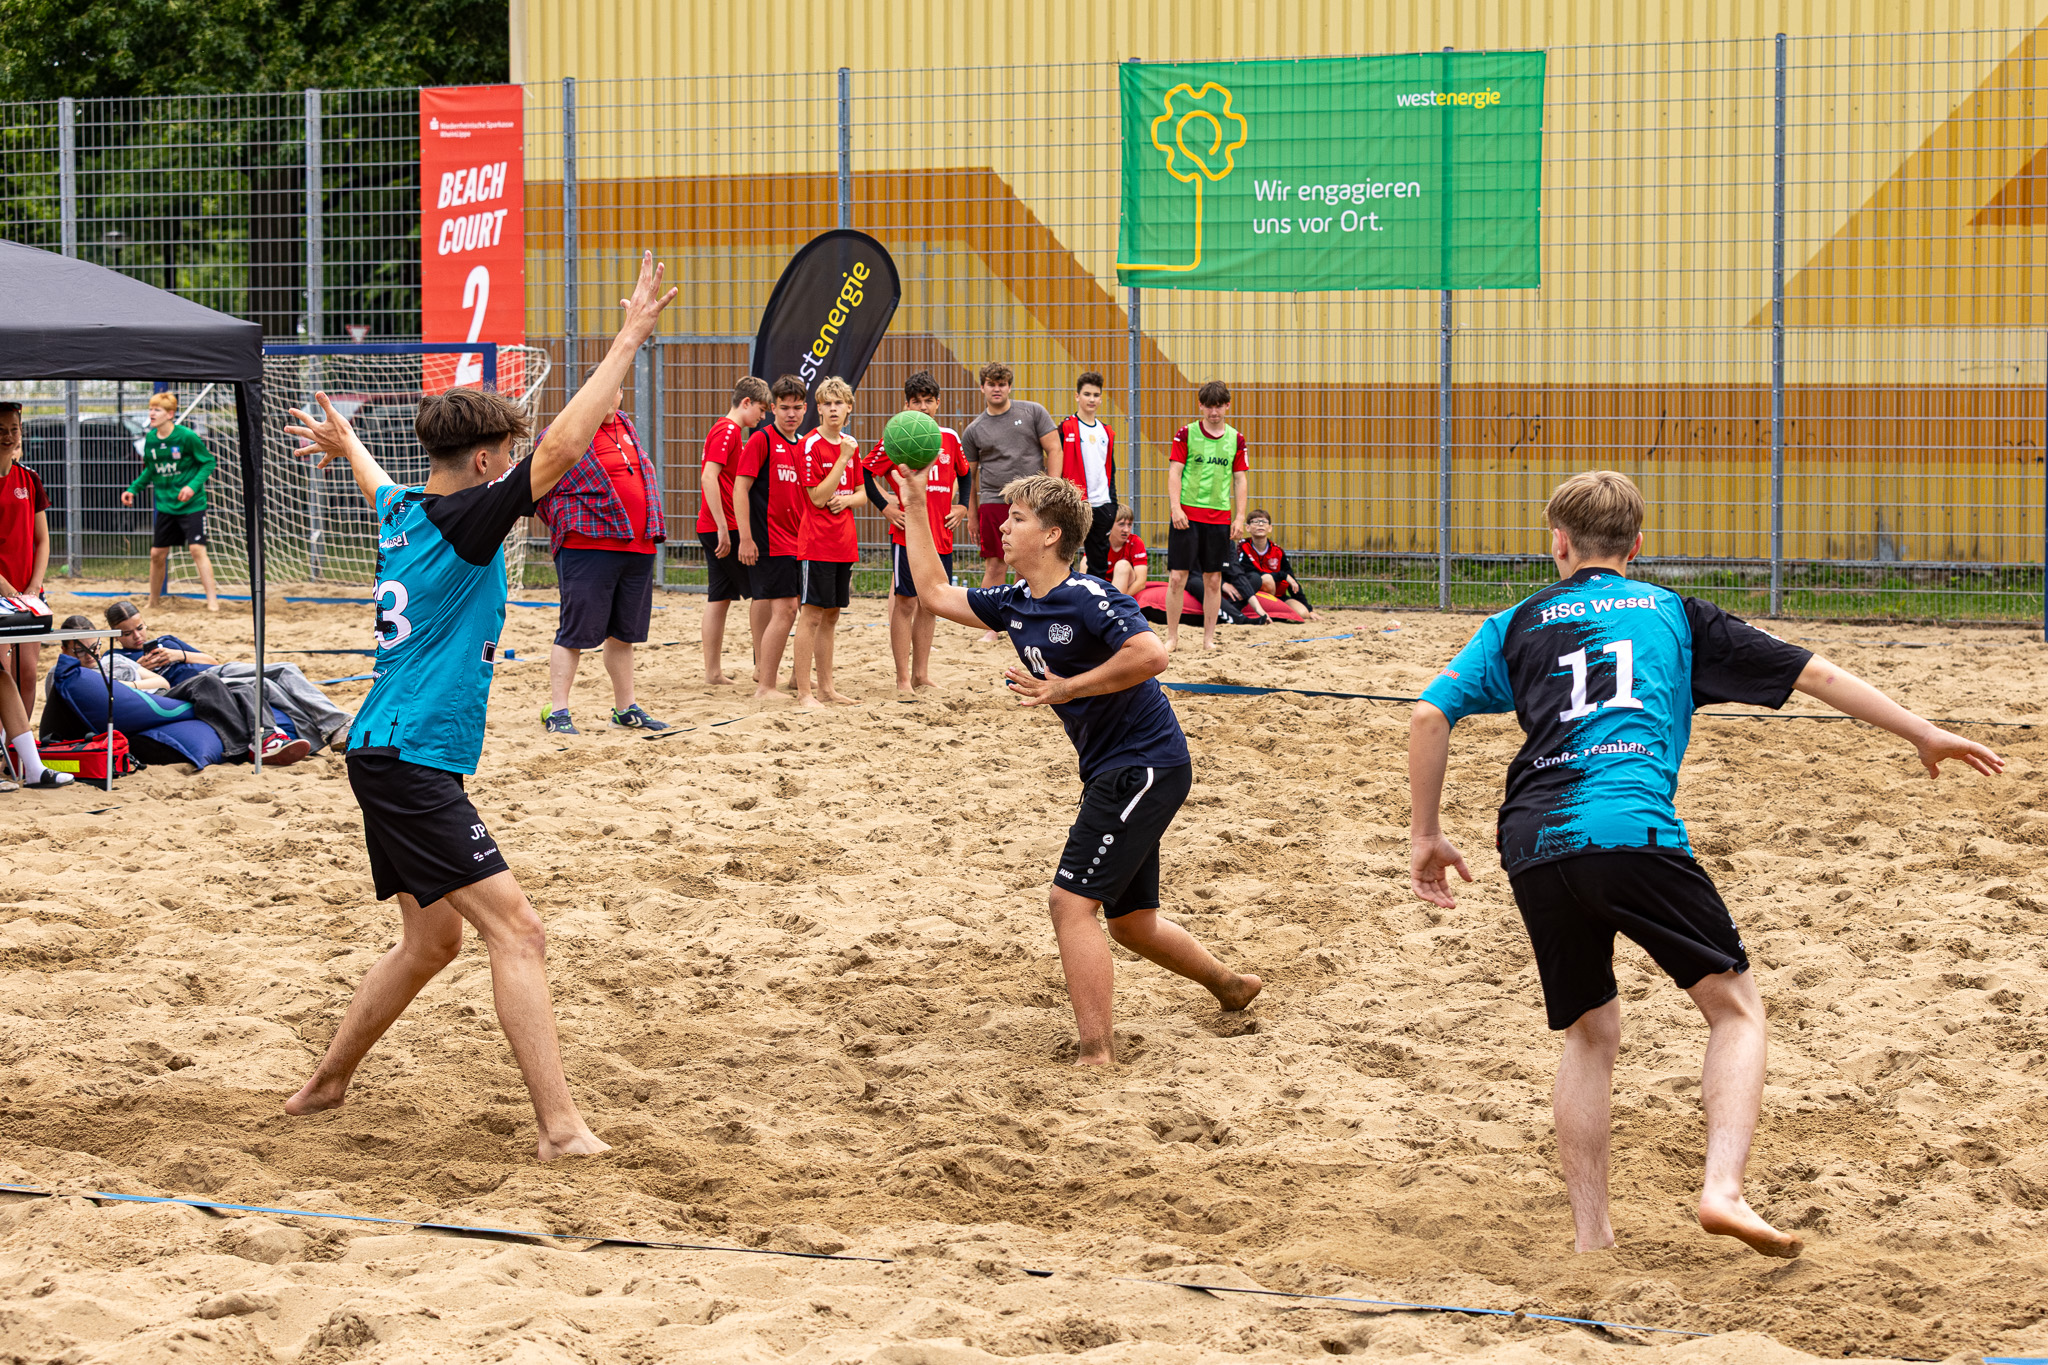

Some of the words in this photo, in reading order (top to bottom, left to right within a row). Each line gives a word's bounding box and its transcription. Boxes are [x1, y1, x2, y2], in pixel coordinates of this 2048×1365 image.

[1396, 87, 1500, 109] westenergie
[437, 161, 508, 209] BEACH
[1254, 180, 1291, 201] Wir
[1298, 177, 1421, 206] engagieren
[438, 208, 508, 256] COURT
[1253, 217, 1291, 234] uns
[1298, 217, 1333, 233] vor
[1340, 210, 1384, 232] Ort.
[454, 265, 490, 386] 2
[1206, 456, 1229, 467] JAKO
[1540, 601, 1586, 624] HSG
[1590, 594, 1658, 614] Wesel
[1010, 619, 1023, 630] JAKO
[1023, 645, 1047, 675] 10
[1558, 639, 1645, 722] 11
[470, 823, 487, 840] JP
[1058, 867, 1074, 880] JAKO
